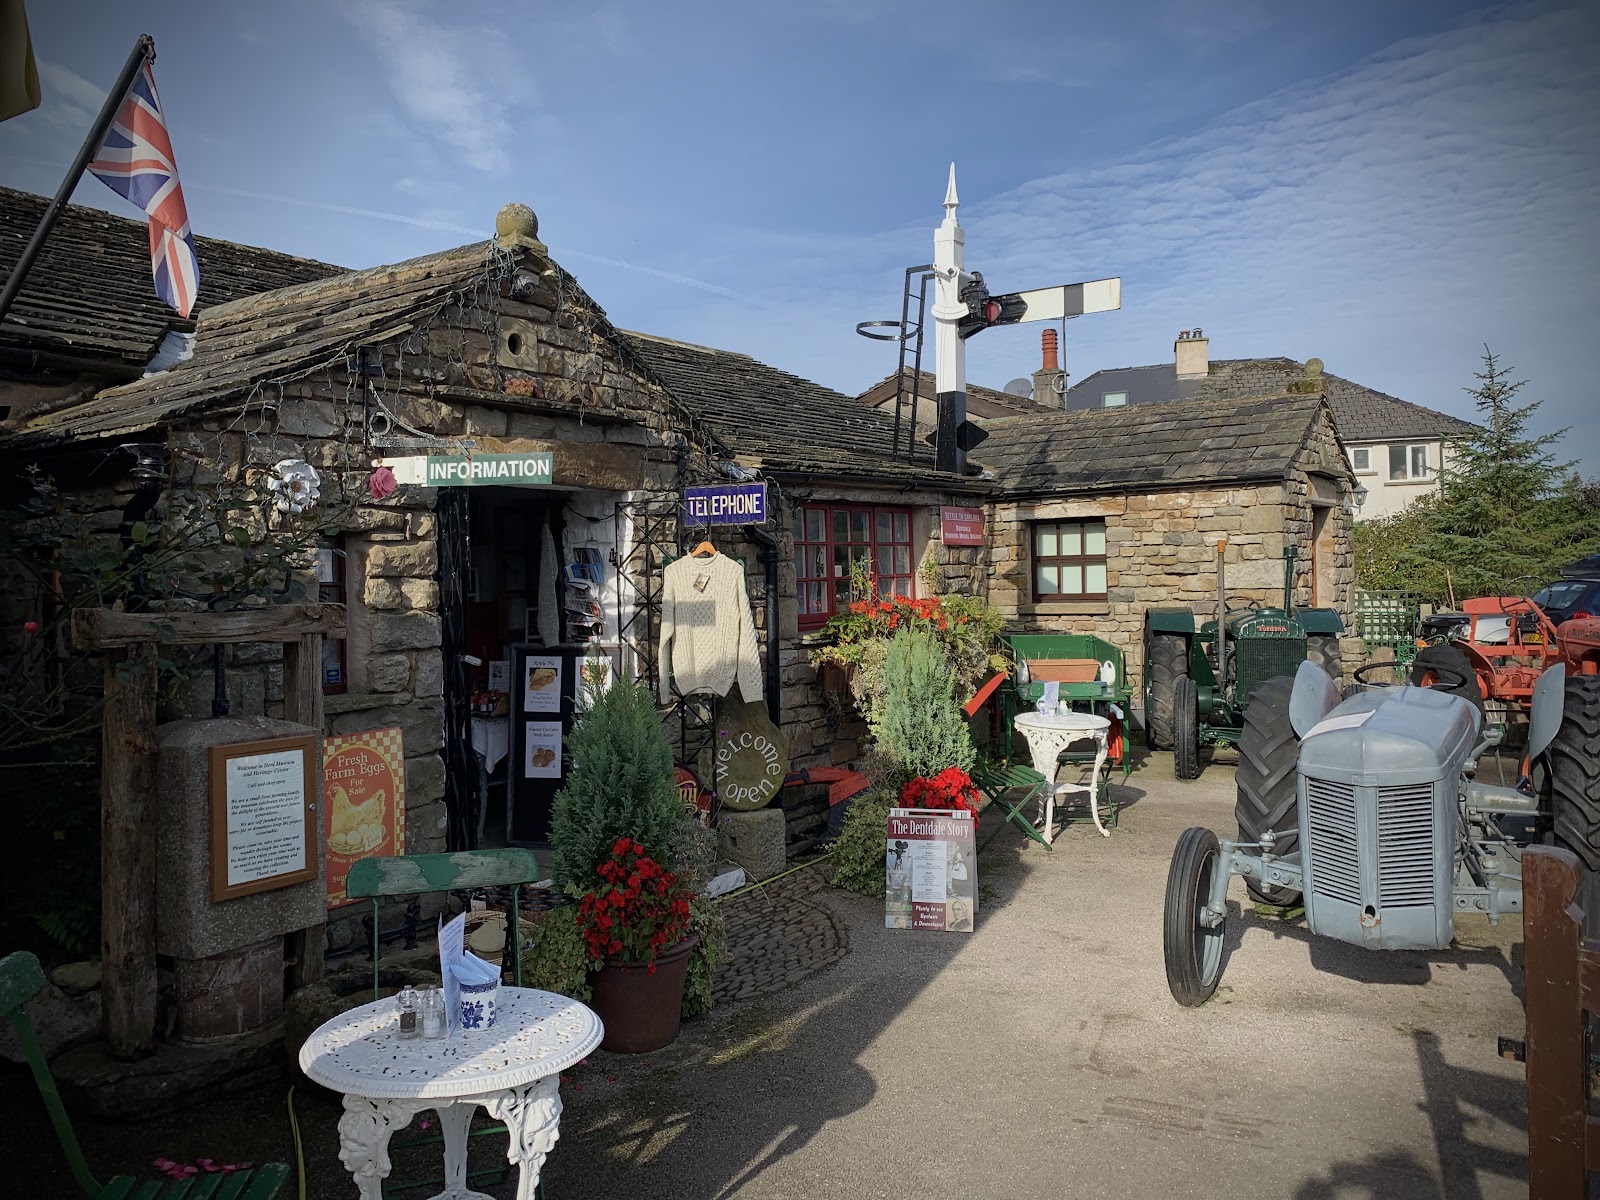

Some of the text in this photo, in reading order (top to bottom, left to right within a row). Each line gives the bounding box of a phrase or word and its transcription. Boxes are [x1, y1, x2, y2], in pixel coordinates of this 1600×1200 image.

[430, 458, 550, 480] INFORMATION
[688, 493, 762, 517] TELEPHONE
[337, 752, 368, 767] Fresh
[324, 762, 386, 781] Farm Eggs
[349, 787, 366, 795] Sale
[350, 778, 364, 786] For
[892, 820, 969, 838] The Dentdale Story
